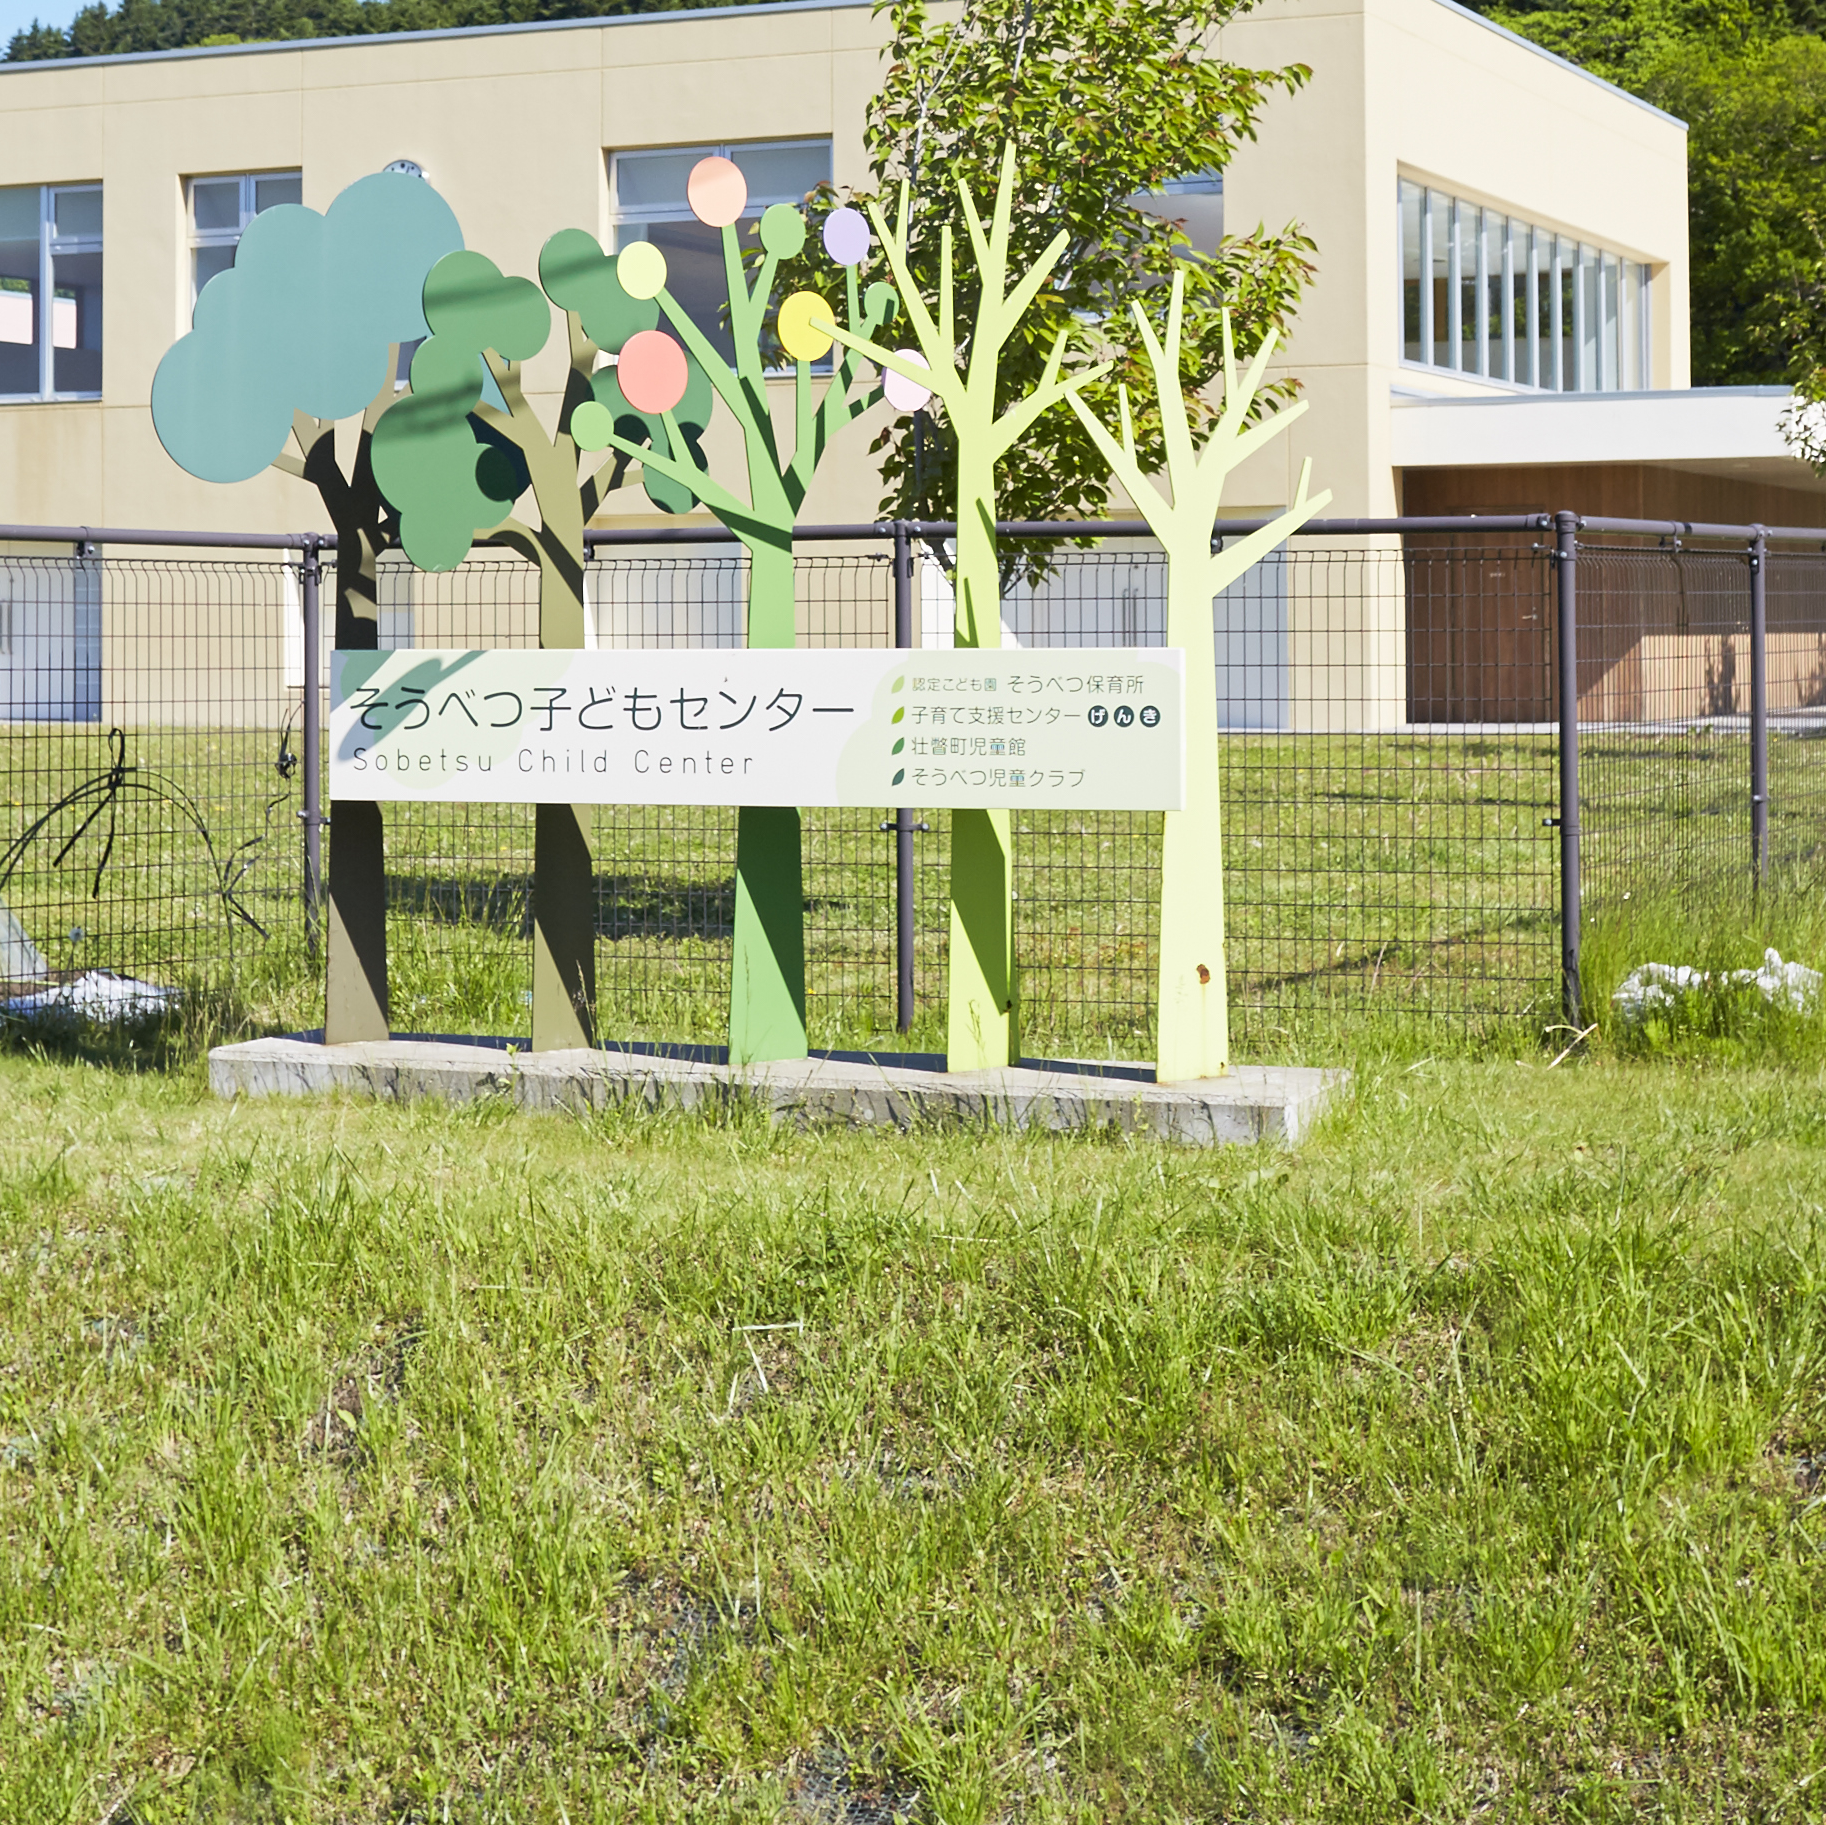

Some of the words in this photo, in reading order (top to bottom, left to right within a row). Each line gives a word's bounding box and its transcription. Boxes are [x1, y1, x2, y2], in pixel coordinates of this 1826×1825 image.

[911, 677, 997, 692] 認定こども園
[1007, 675, 1144, 694] そうべつ保育所
[349, 686, 855, 733] そうべつ子どもセンター
[911, 706, 1081, 725] 子育て支援センター
[911, 737, 1026, 756] 壮瞥町児童館
[353, 747, 493, 773] Sobetsu
[518, 748, 608, 774] Child
[634, 749, 754, 776] Center
[911, 768, 1086, 787] そうべつ児童クラブ
